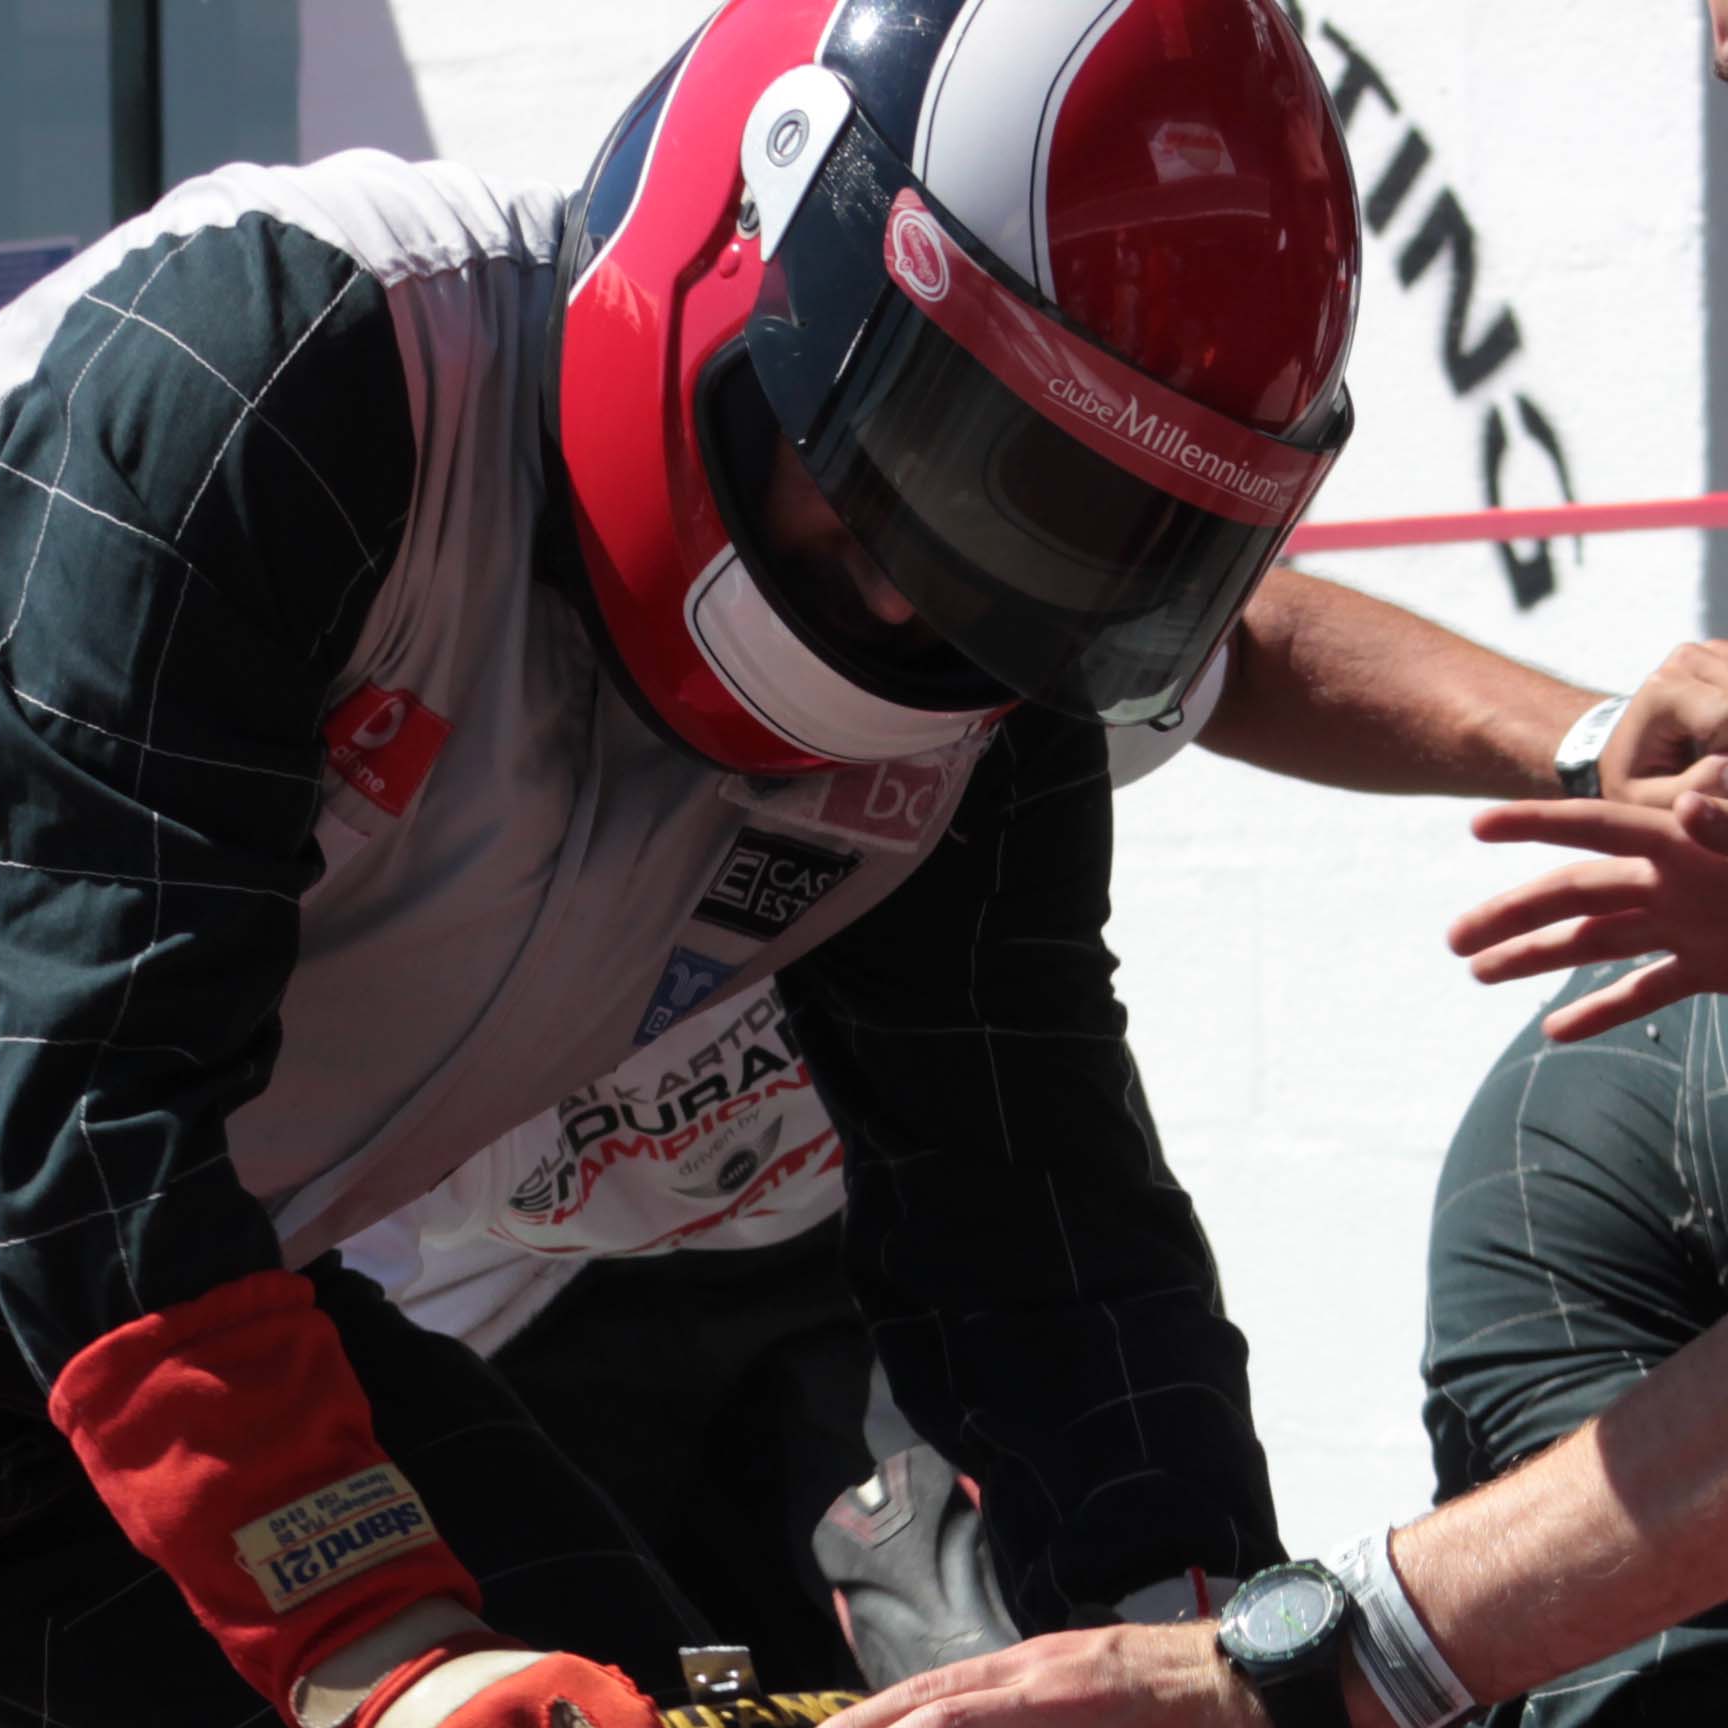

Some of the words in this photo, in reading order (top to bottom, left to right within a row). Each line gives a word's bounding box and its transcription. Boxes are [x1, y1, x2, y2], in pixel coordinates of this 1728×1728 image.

[1047, 377, 1114, 423] clube
[1113, 393, 1280, 503] Millennium
[317, 1500, 423, 1570] stand
